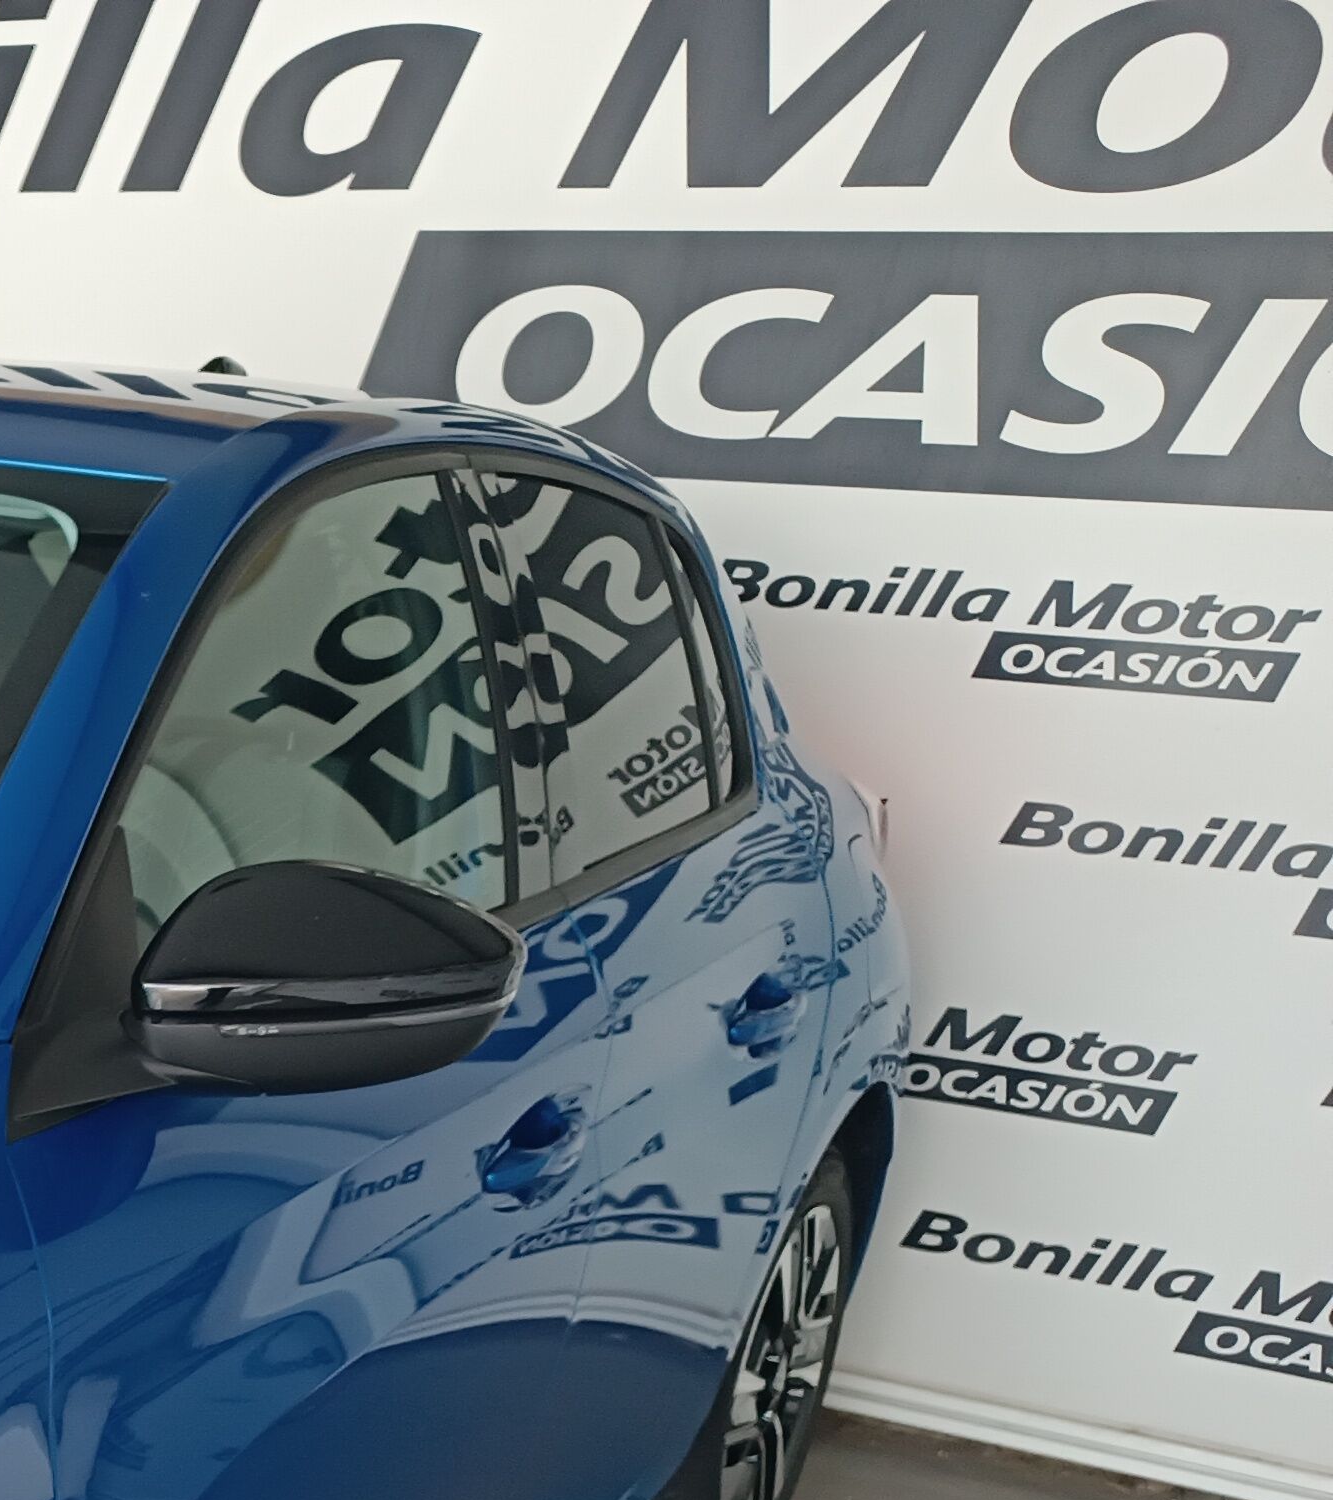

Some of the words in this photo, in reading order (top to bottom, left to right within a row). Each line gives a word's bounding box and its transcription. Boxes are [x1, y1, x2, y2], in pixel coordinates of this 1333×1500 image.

[455, 283, 1333, 457] OCASI
[723, 557, 1010, 622] Bonilla
[1027, 579, 1321, 644] Motor
[1001, 643, 1274, 693] OCASIÓN
[999, 800, 1333, 879] Bonilla
[923, 1006, 1198, 1082] Motor
[903, 1062, 1154, 1126] OCASIÓN
[899, 1209, 1214, 1302] Bonilla
